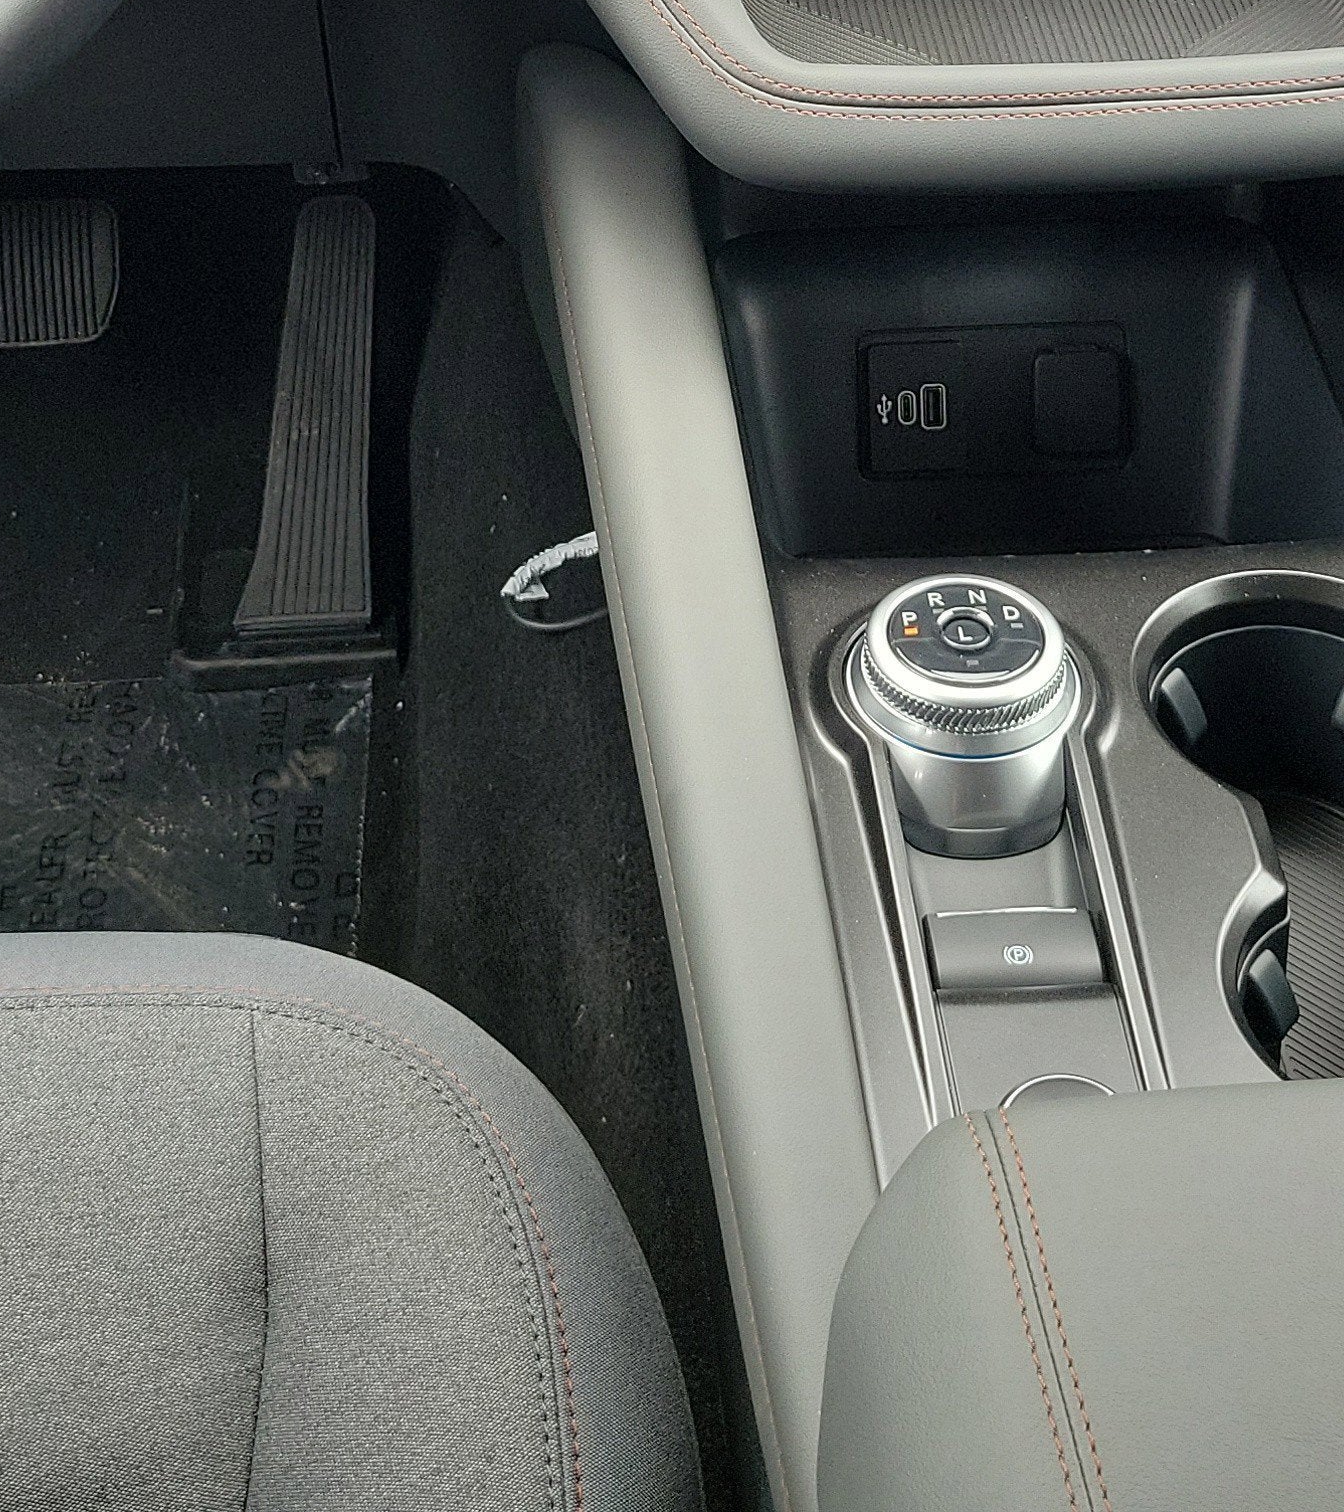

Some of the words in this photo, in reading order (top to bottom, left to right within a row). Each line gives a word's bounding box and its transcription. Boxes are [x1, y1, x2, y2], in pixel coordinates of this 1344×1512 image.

[901, 610, 918, 627] P
[926, 591, 945, 608] R
[967, 589, 988, 605] N
[1002, 605, 1022, 621] D
[957, 625, 974, 642] L
